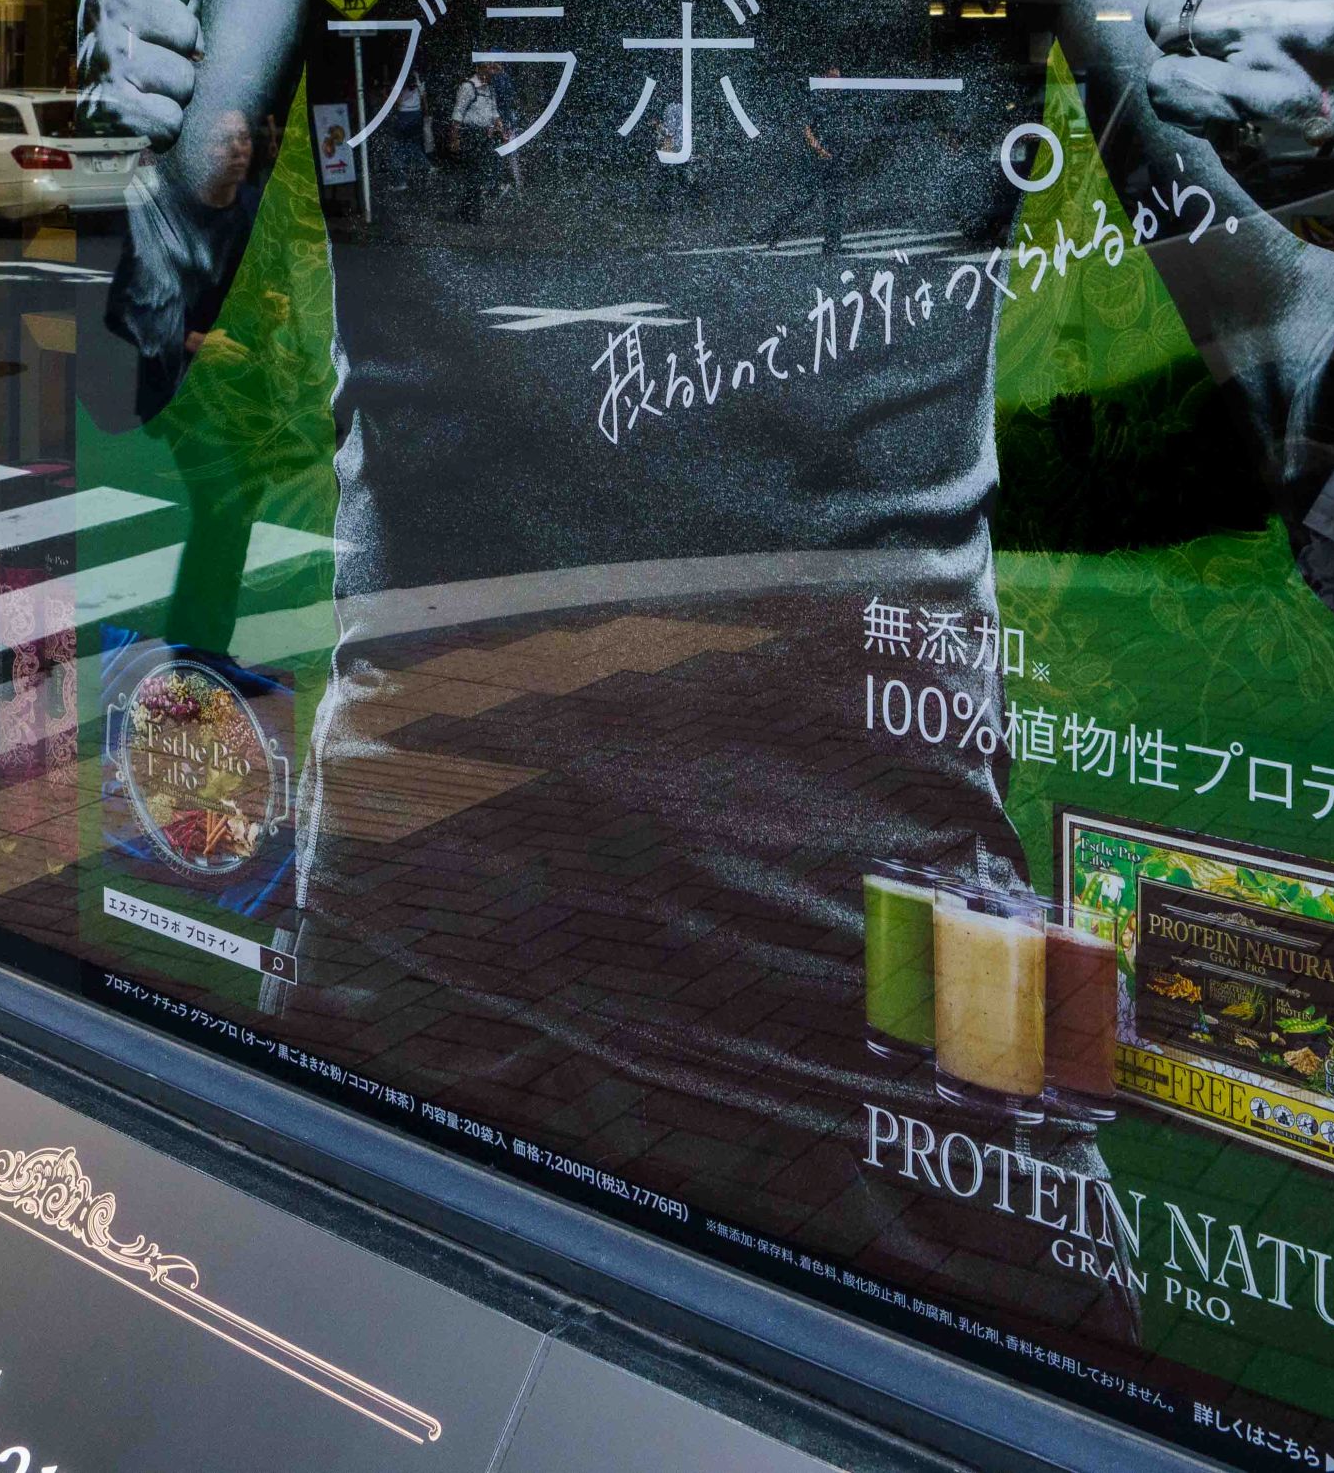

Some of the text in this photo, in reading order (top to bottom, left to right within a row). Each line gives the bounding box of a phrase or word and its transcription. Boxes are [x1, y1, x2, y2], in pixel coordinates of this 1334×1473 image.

[212, 740, 252, 777] Pro
[1080, 837, 1142, 864] Esthe Pro
[109, 897, 240, 955] エステプロラボ プロテイン
[1147, 913, 1240, 957] PROTEIN
[1209, 952, 1242, 969] GRAN
[104, 973, 149, 1002] プロテイン
[152, 992, 188, 1018] ナチュラ
[190, 1007, 238, 1039] グランプロ
[1275, 1005, 1313, 1021] PROTEIN
[1168, 1062, 1248, 1124] FREE
[862, 1102, 1148, 1259] PROTEIN
[1051, 1238, 1236, 1327] GRAN PRO.
[1193, 1401, 1320, 1468] 詳しくはこちら
